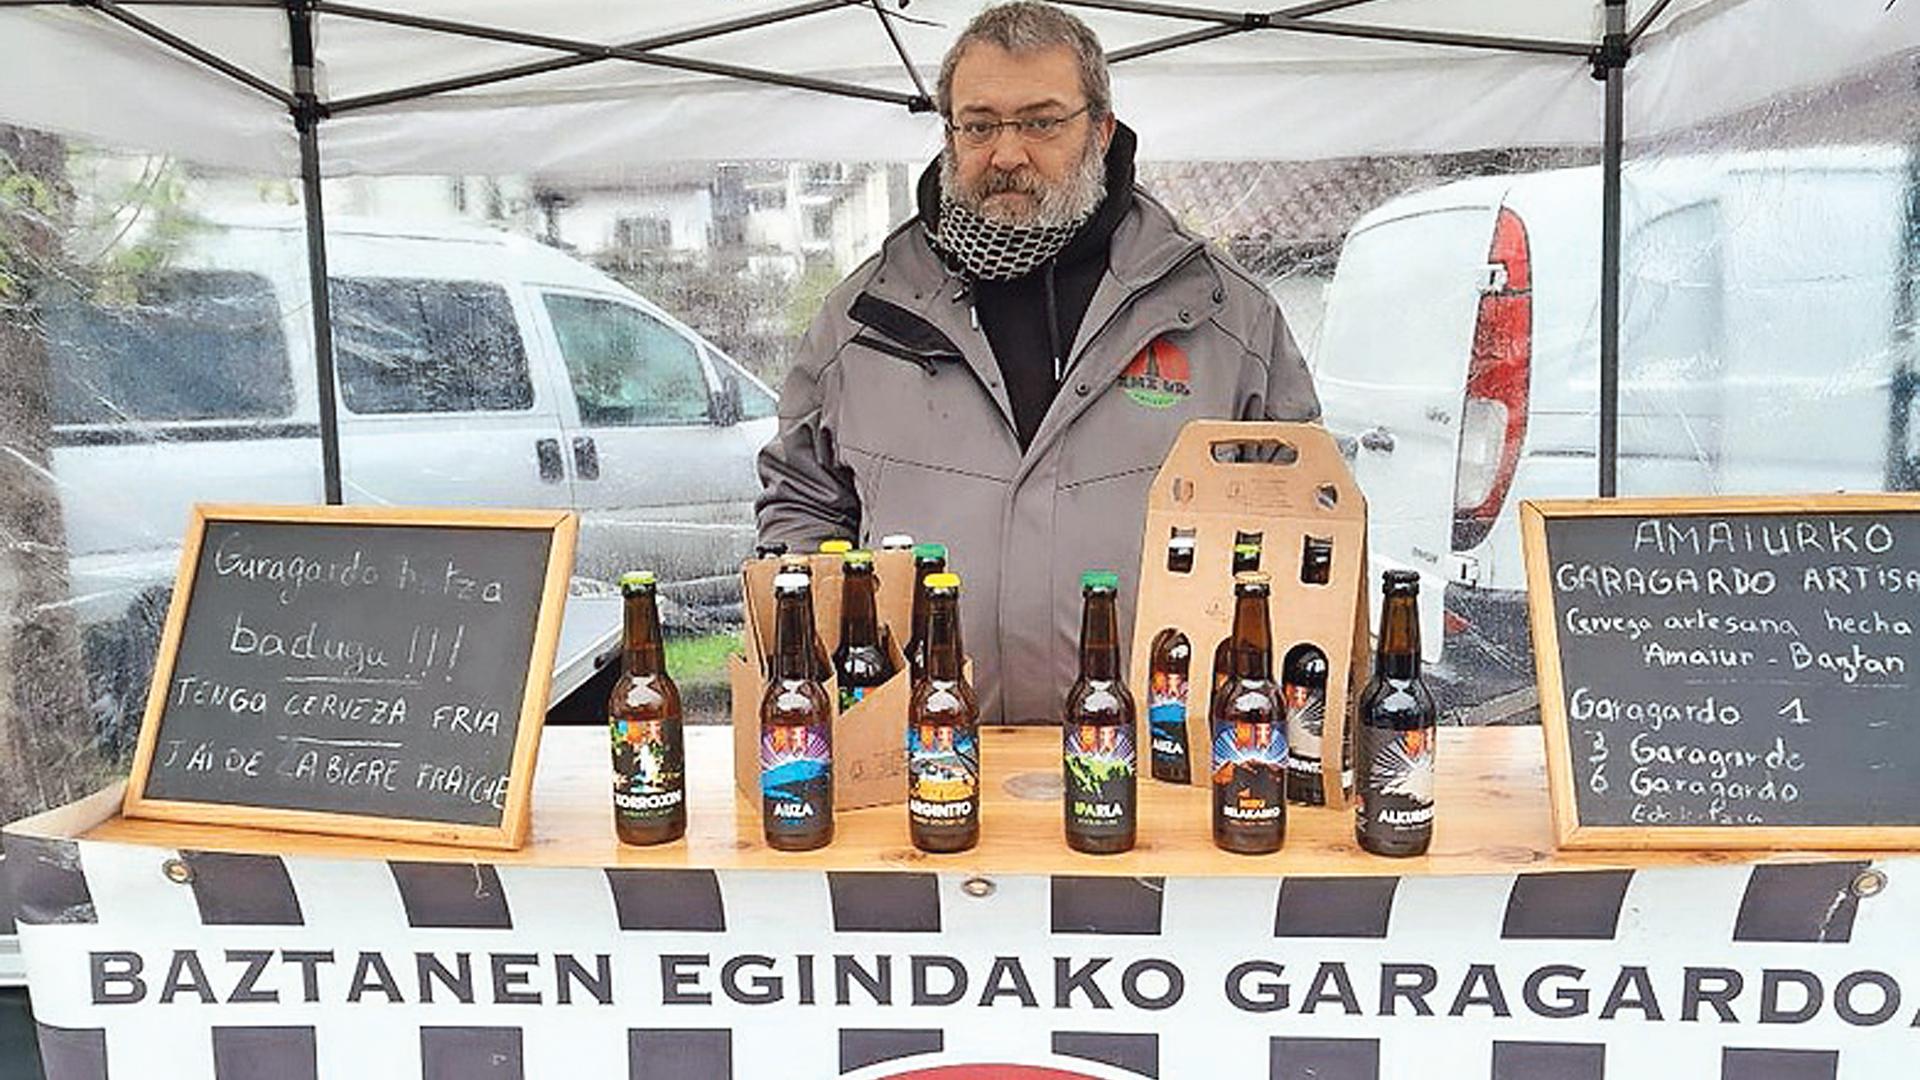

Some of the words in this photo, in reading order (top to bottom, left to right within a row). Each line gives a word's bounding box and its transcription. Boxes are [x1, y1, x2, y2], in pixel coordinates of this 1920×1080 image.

[399, 557, 502, 602] htza
[1556, 562, 1777, 597] GARAGARDO
[230, 612, 389, 674] badugu
[1663, 608, 1800, 638] artesana
[1823, 607, 1913, 636] hecha
[1788, 641, 1905, 684] Baztan
[176, 678, 267, 714] TENGO
[284, 692, 408, 726] CERVEZA
[432, 703, 500, 735] FRIA
[1570, 687, 1741, 731] Garagardo
[1777, 697, 1813, 725] 1
[225, 748, 264, 777] DE
[1590, 763, 1609, 794] 6
[773, 802, 815, 818] AUZA
[90, 949, 614, 1006] BAZTANEN
[659, 952, 1185, 1012] EGINDAKO
[1224, 960, 1920, 1028] GARAGARDO
